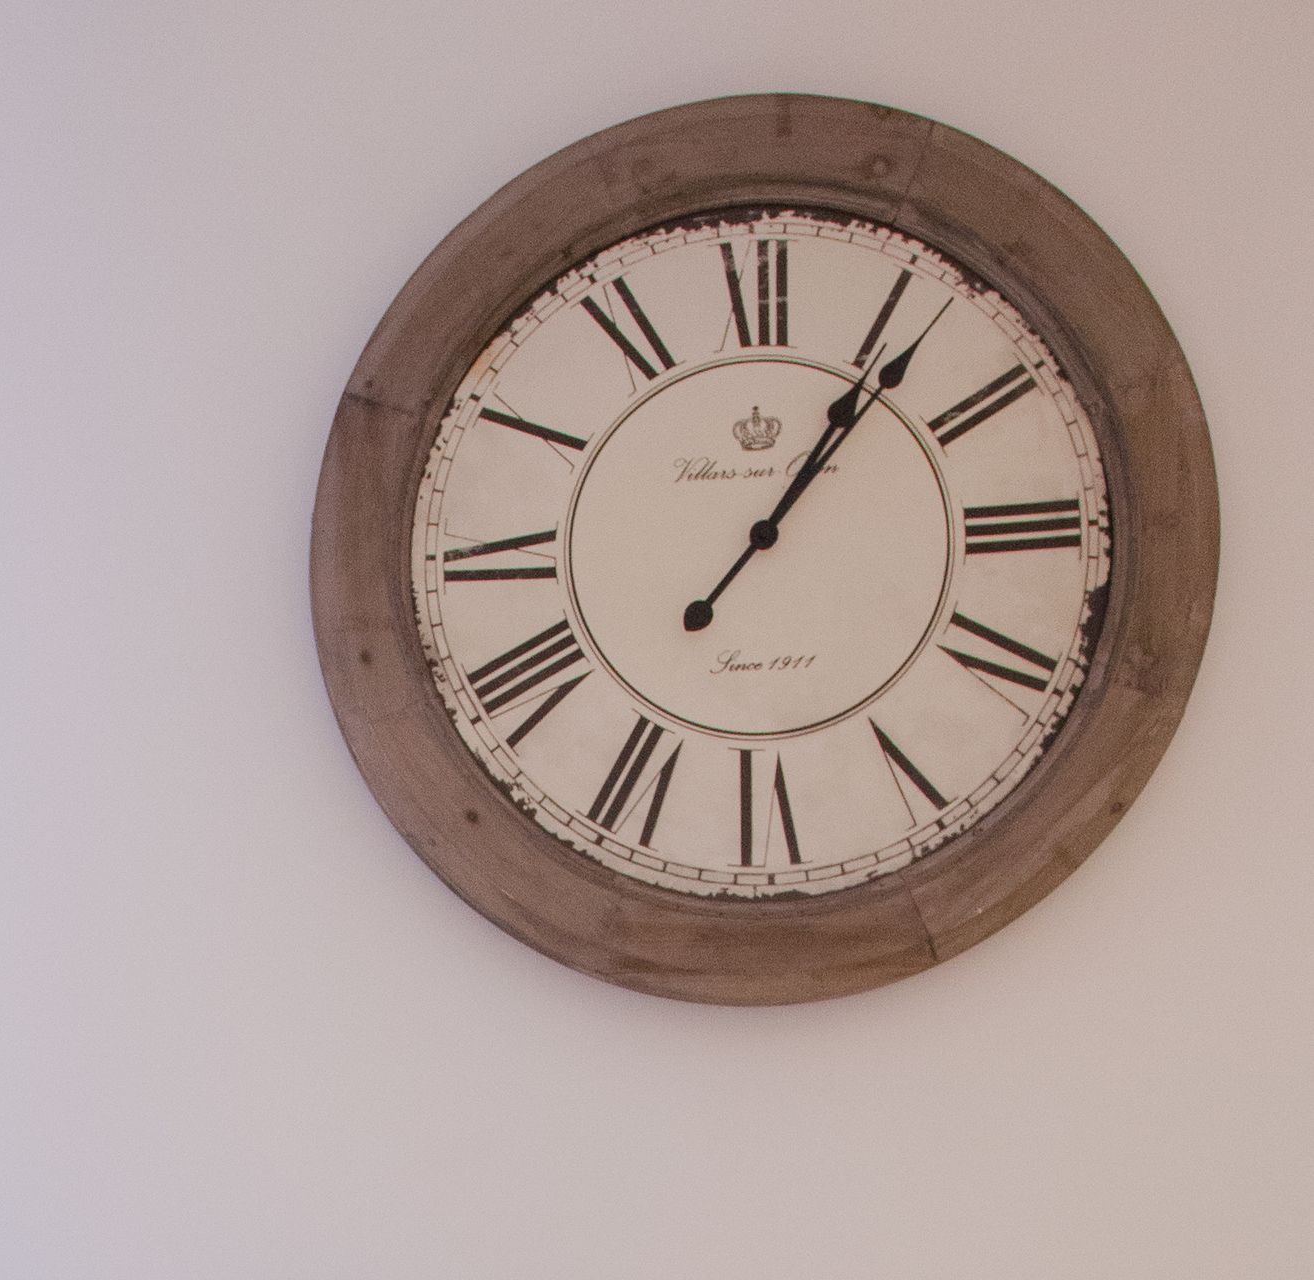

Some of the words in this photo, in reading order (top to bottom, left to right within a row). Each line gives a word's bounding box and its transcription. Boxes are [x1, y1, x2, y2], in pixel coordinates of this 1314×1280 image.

[570, 270, 685, 398] XI
[708, 239, 798, 353] XII
[472, 381, 595, 475] X
[919, 352, 1044, 457] II
[443, 520, 558, 595] IX
[960, 490, 1082, 564] III
[461, 609, 595, 757] VIII
[709, 650, 763, 674] Since
[768, 655, 816, 670] 1911
[936, 600, 1064, 726] IV
[575, 708, 684, 852] VII
[727, 747, 813, 867] VI
[868, 716, 958, 830] V
